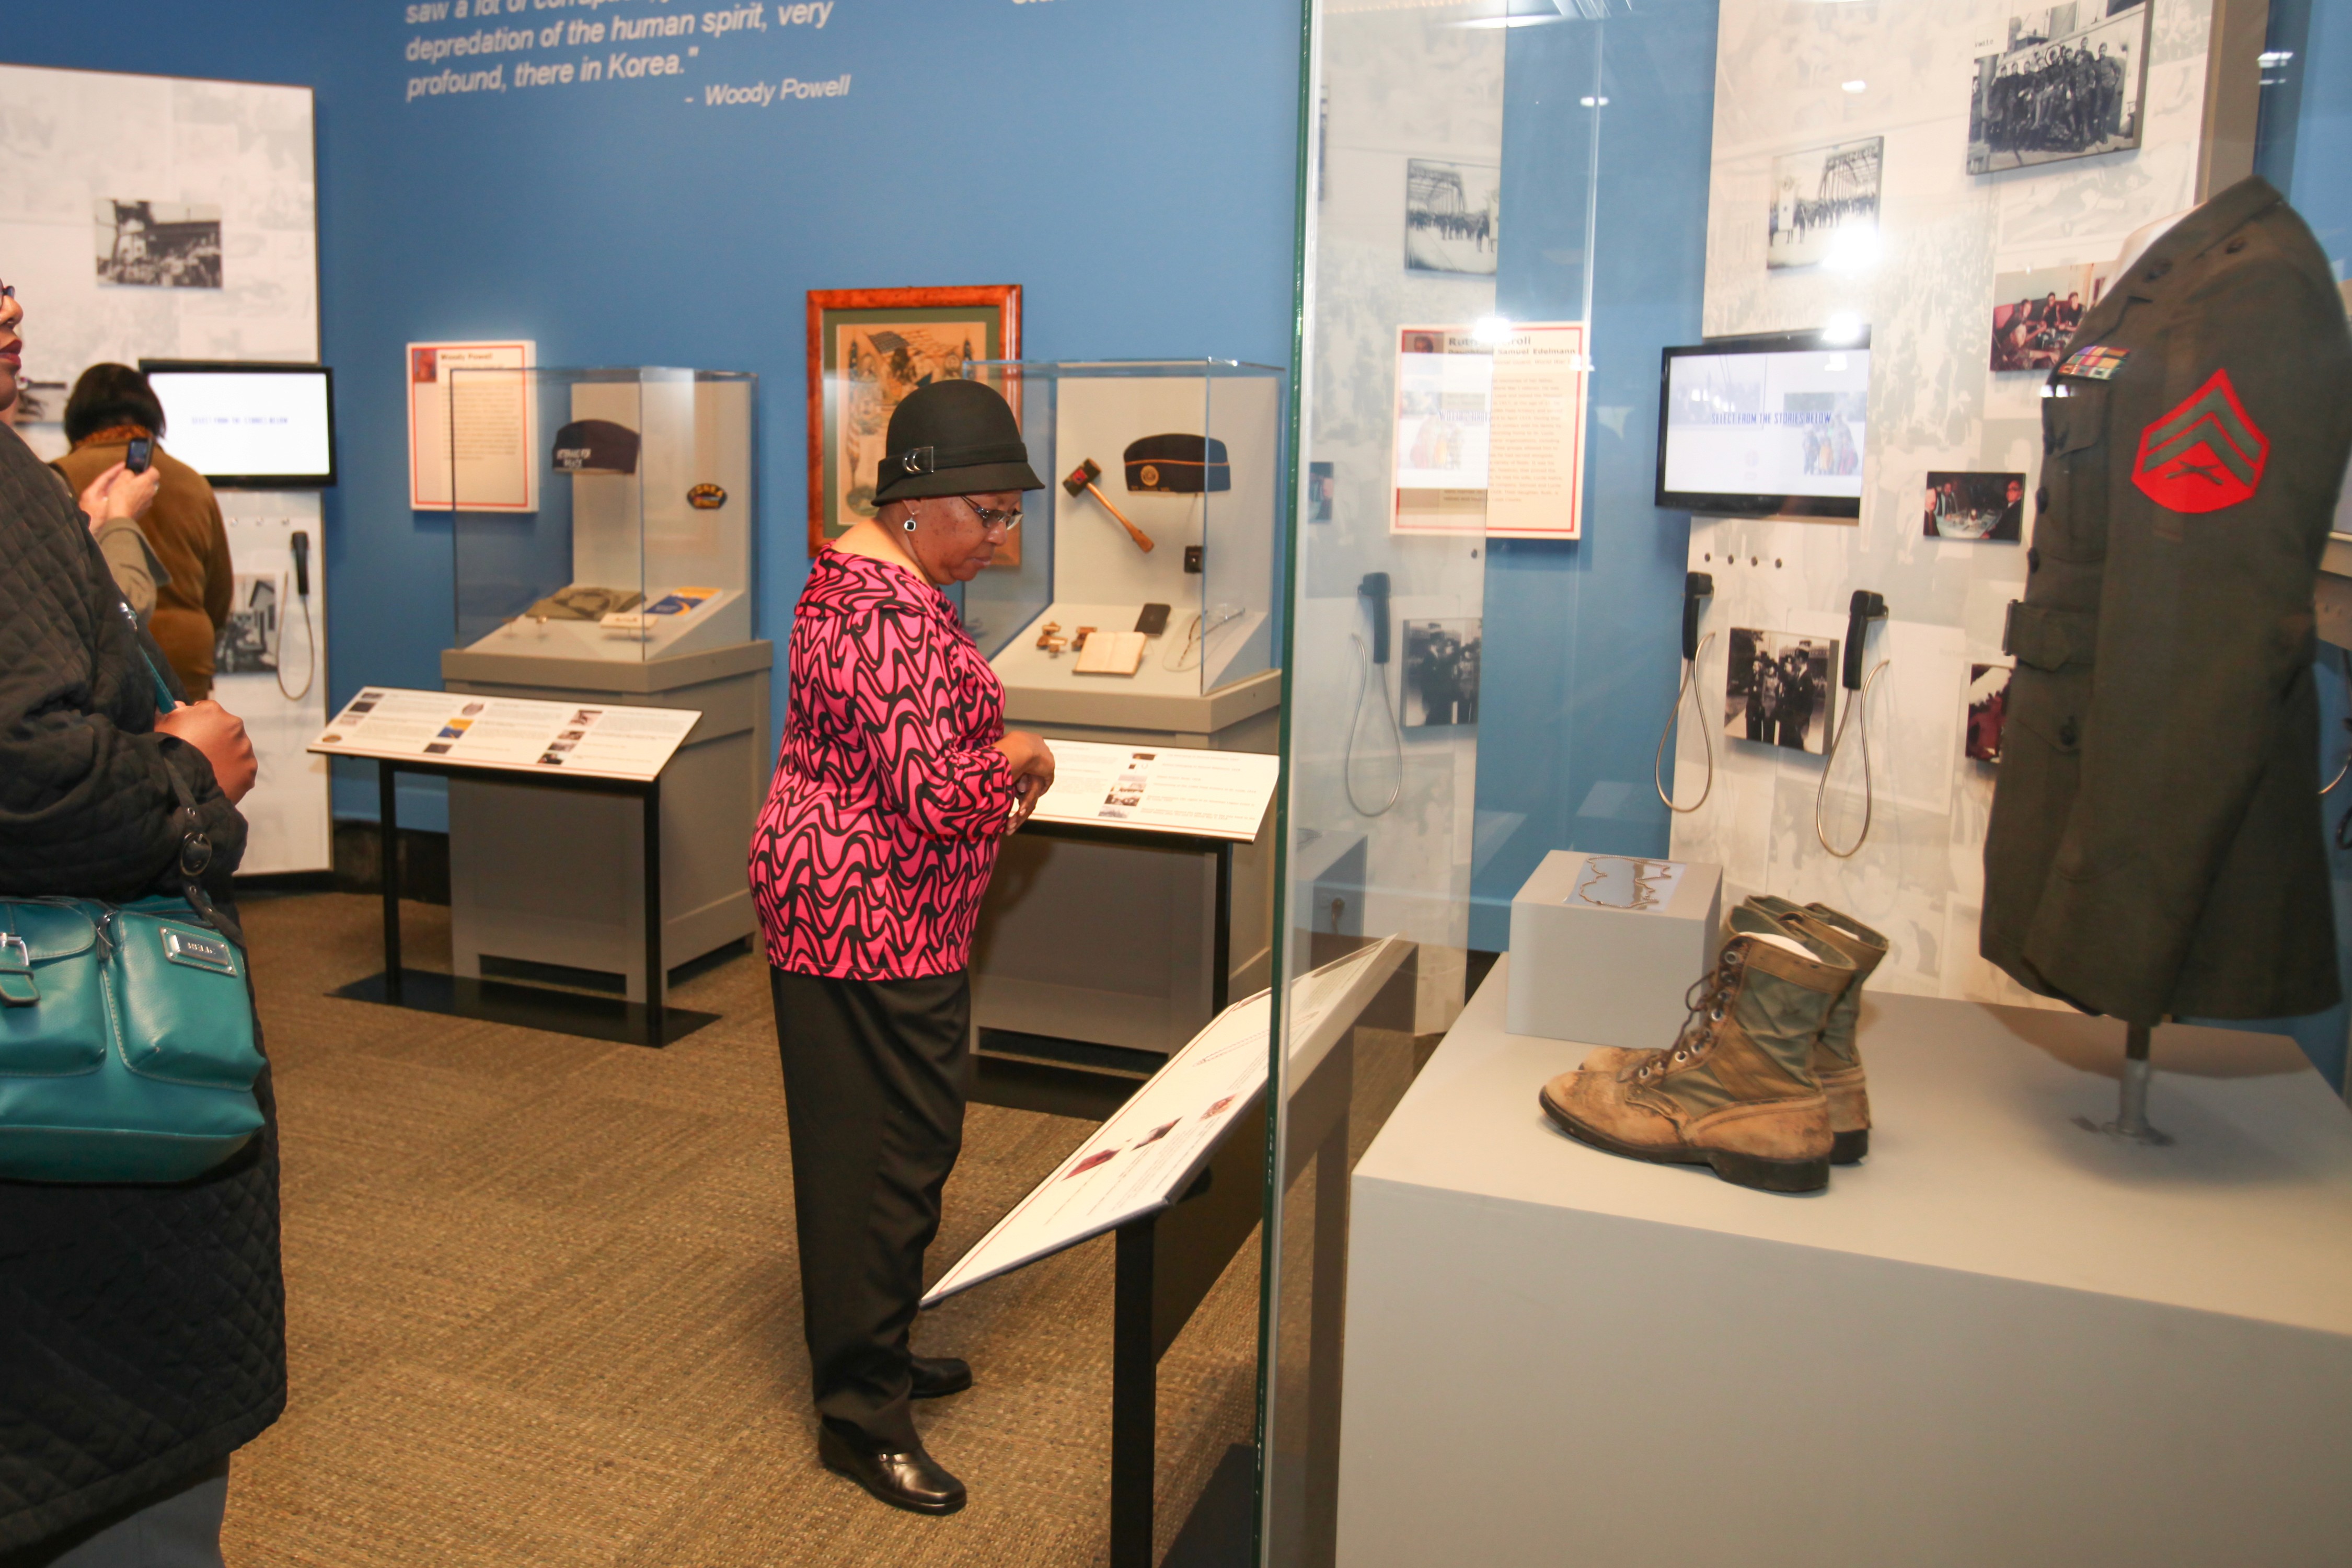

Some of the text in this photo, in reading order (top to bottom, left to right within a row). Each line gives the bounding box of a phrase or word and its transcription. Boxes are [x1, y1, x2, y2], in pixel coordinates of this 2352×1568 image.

[405, 2, 449, 24] saw
[454, 1, 469, 19] a
[474, 0, 500, 17] lot
[405, 1, 834, 65] depredation of the human spirit, very
[406, 45, 700, 103] profound, there in Korea."
[705, 80, 776, 107] Woody
[779, 73, 852, 100] Powell
[1711, 412, 1832, 424] SELECT FROM THE STORIES BELOW
